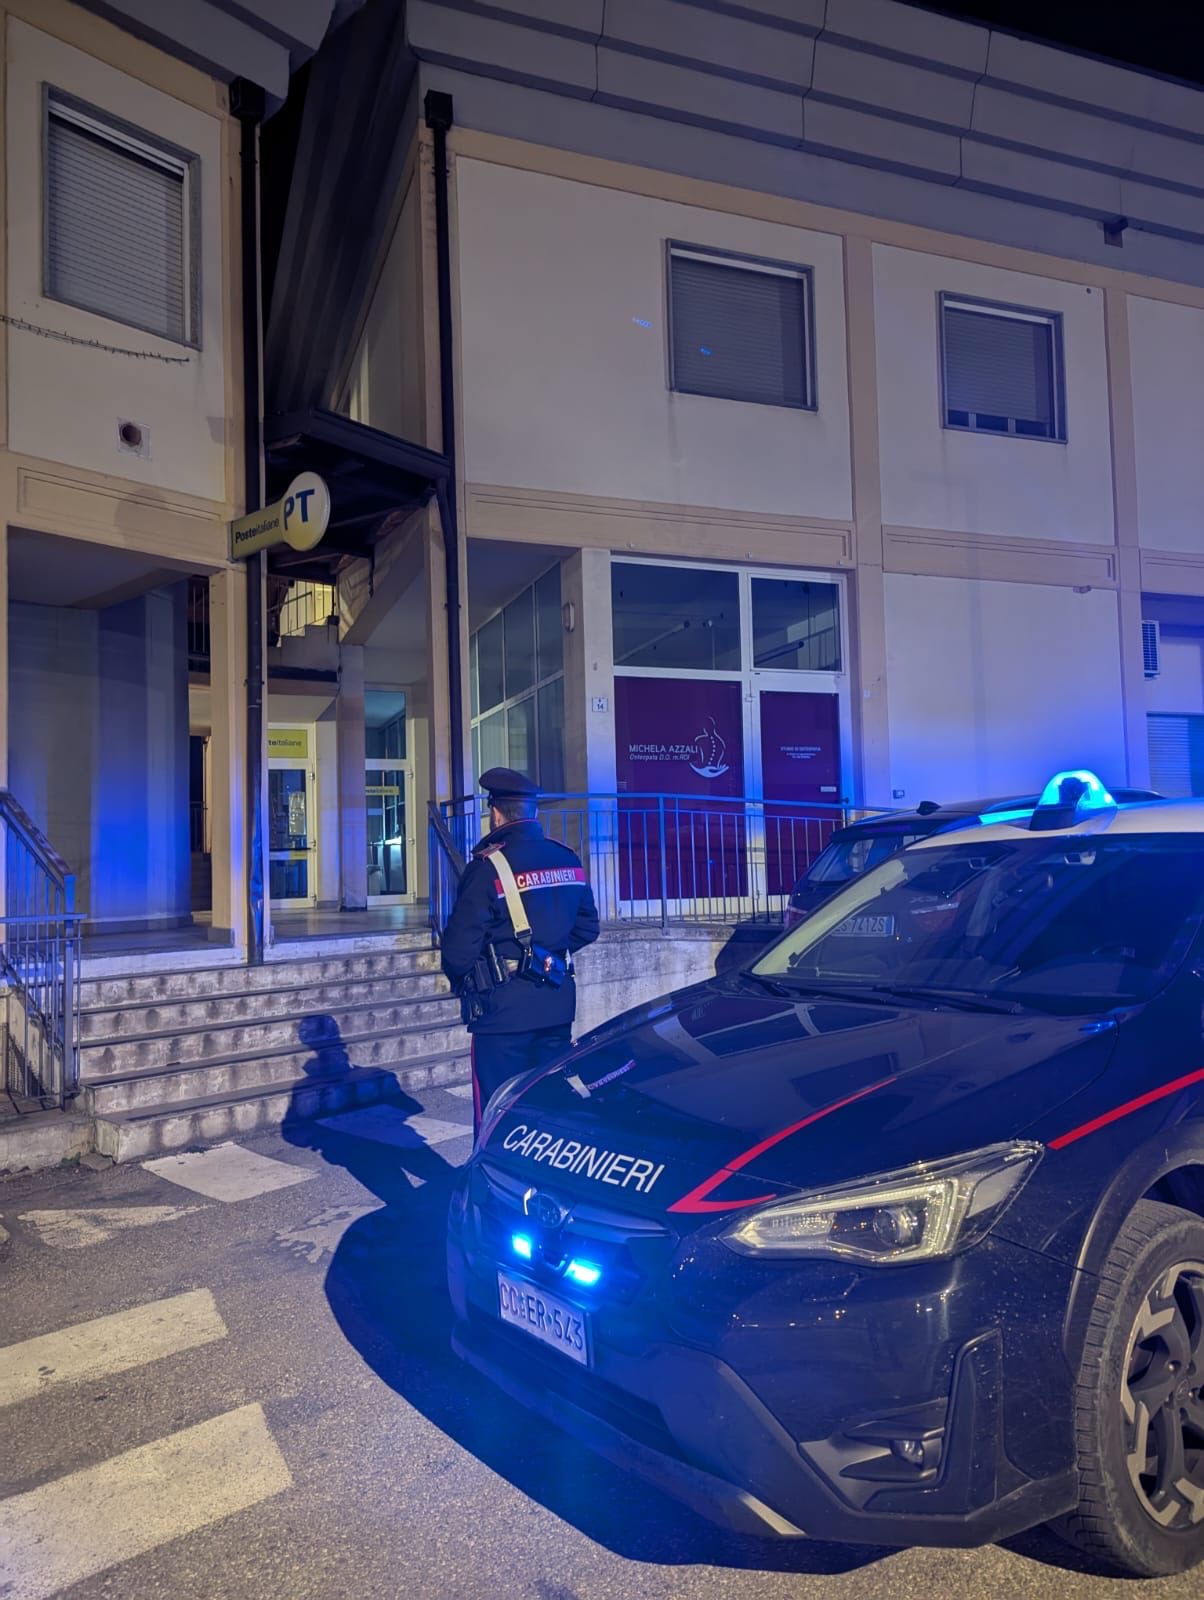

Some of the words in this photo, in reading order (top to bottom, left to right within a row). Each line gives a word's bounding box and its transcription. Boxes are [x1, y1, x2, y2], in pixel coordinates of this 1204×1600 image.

[283, 488, 315, 531] PT
[629, 744, 666, 753] MICHELA
[668, 745, 698, 753] AZZALI
[516, 869, 576, 888] CARABINIERI
[503, 1124, 665, 1193] CARABINIERI
